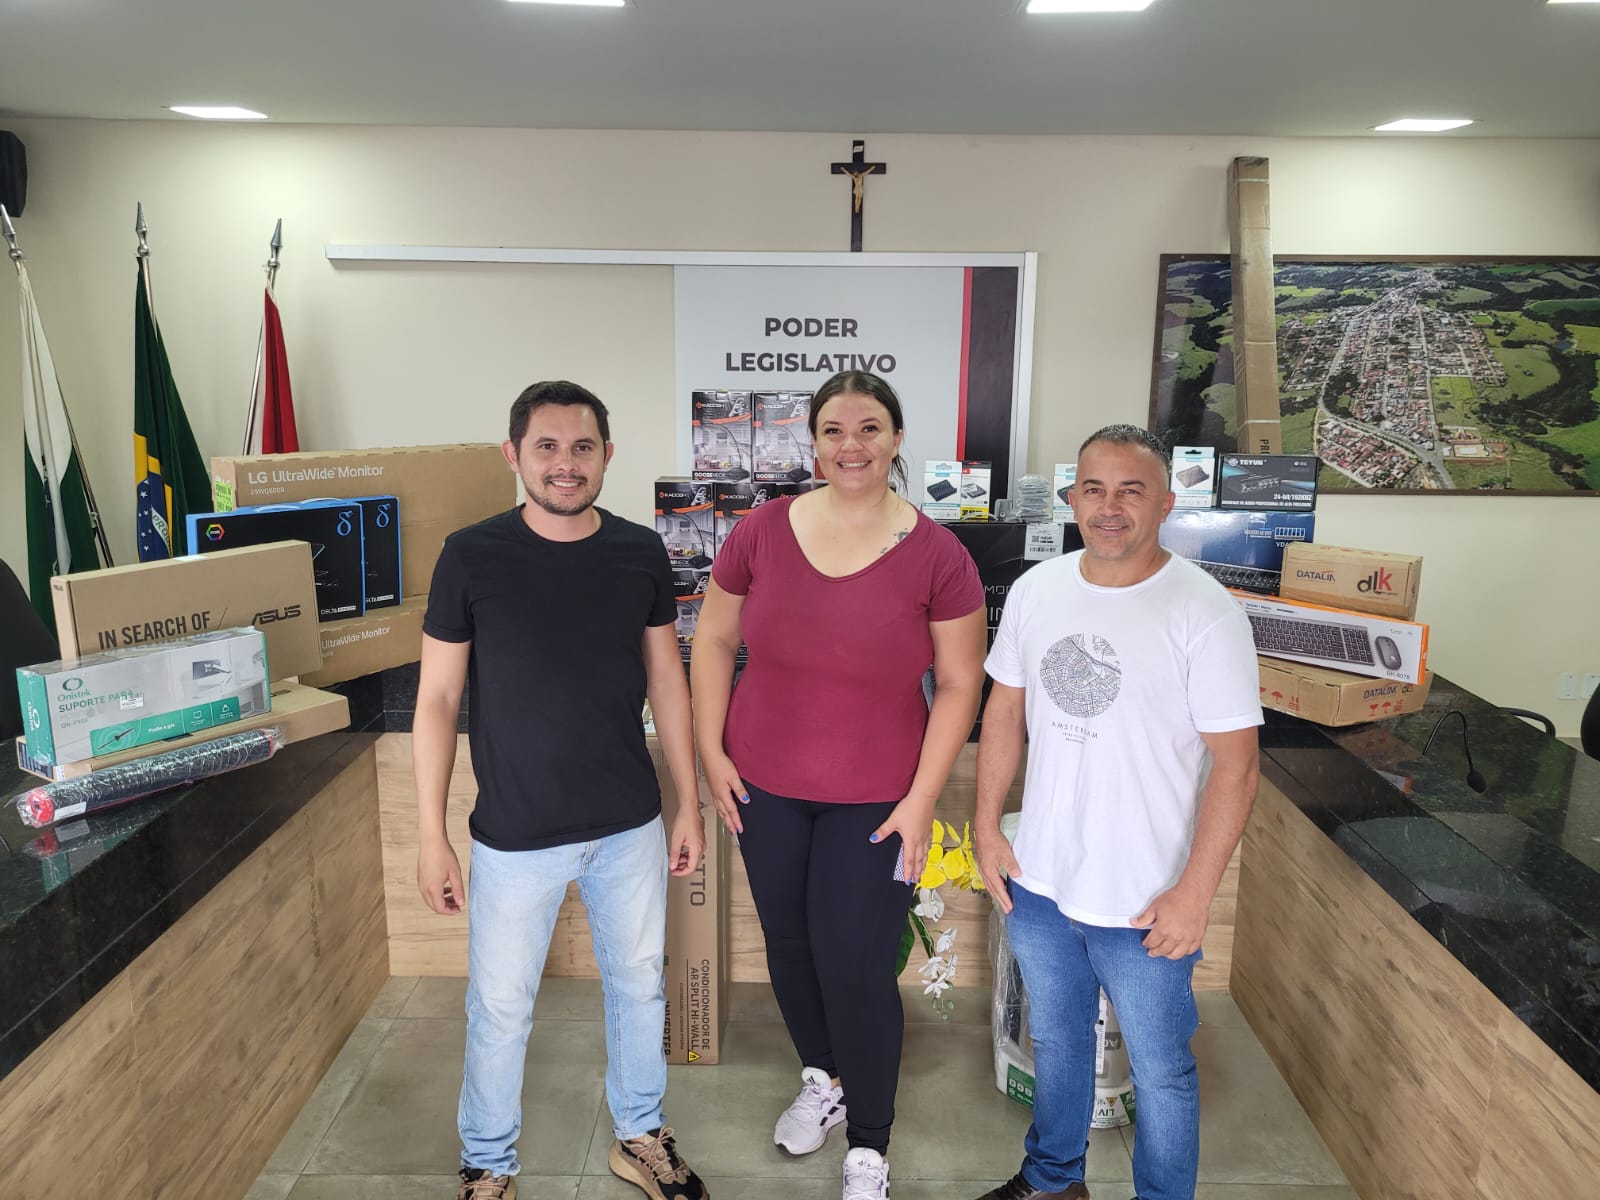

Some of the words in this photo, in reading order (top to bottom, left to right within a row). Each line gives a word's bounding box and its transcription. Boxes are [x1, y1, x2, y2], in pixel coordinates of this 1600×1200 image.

[765, 317, 858, 337] PODER
[726, 353, 897, 373] LEGISLATIVO
[248, 471, 269, 485] LG
[338, 465, 384, 478] Monitor
[251, 604, 302, 625] ASUS
[98, 631, 117, 650] IN
[123, 617, 188, 645] SEARCH
[192, 610, 211, 631] OF
[361, 626, 391, 641] Monitor
[57, 689, 91, 701] Onistek
[59, 695, 106, 713] SUPORTE
[108, 690, 134, 703] PARA
[690, 967, 699, 980] AR
[690, 981, 700, 1008] SPLIT
[701, 959, 710, 1036] CONDICIONADOR
[690, 1010, 700, 1050] HI-WALL
[701, 1038, 710, 1050] DE
